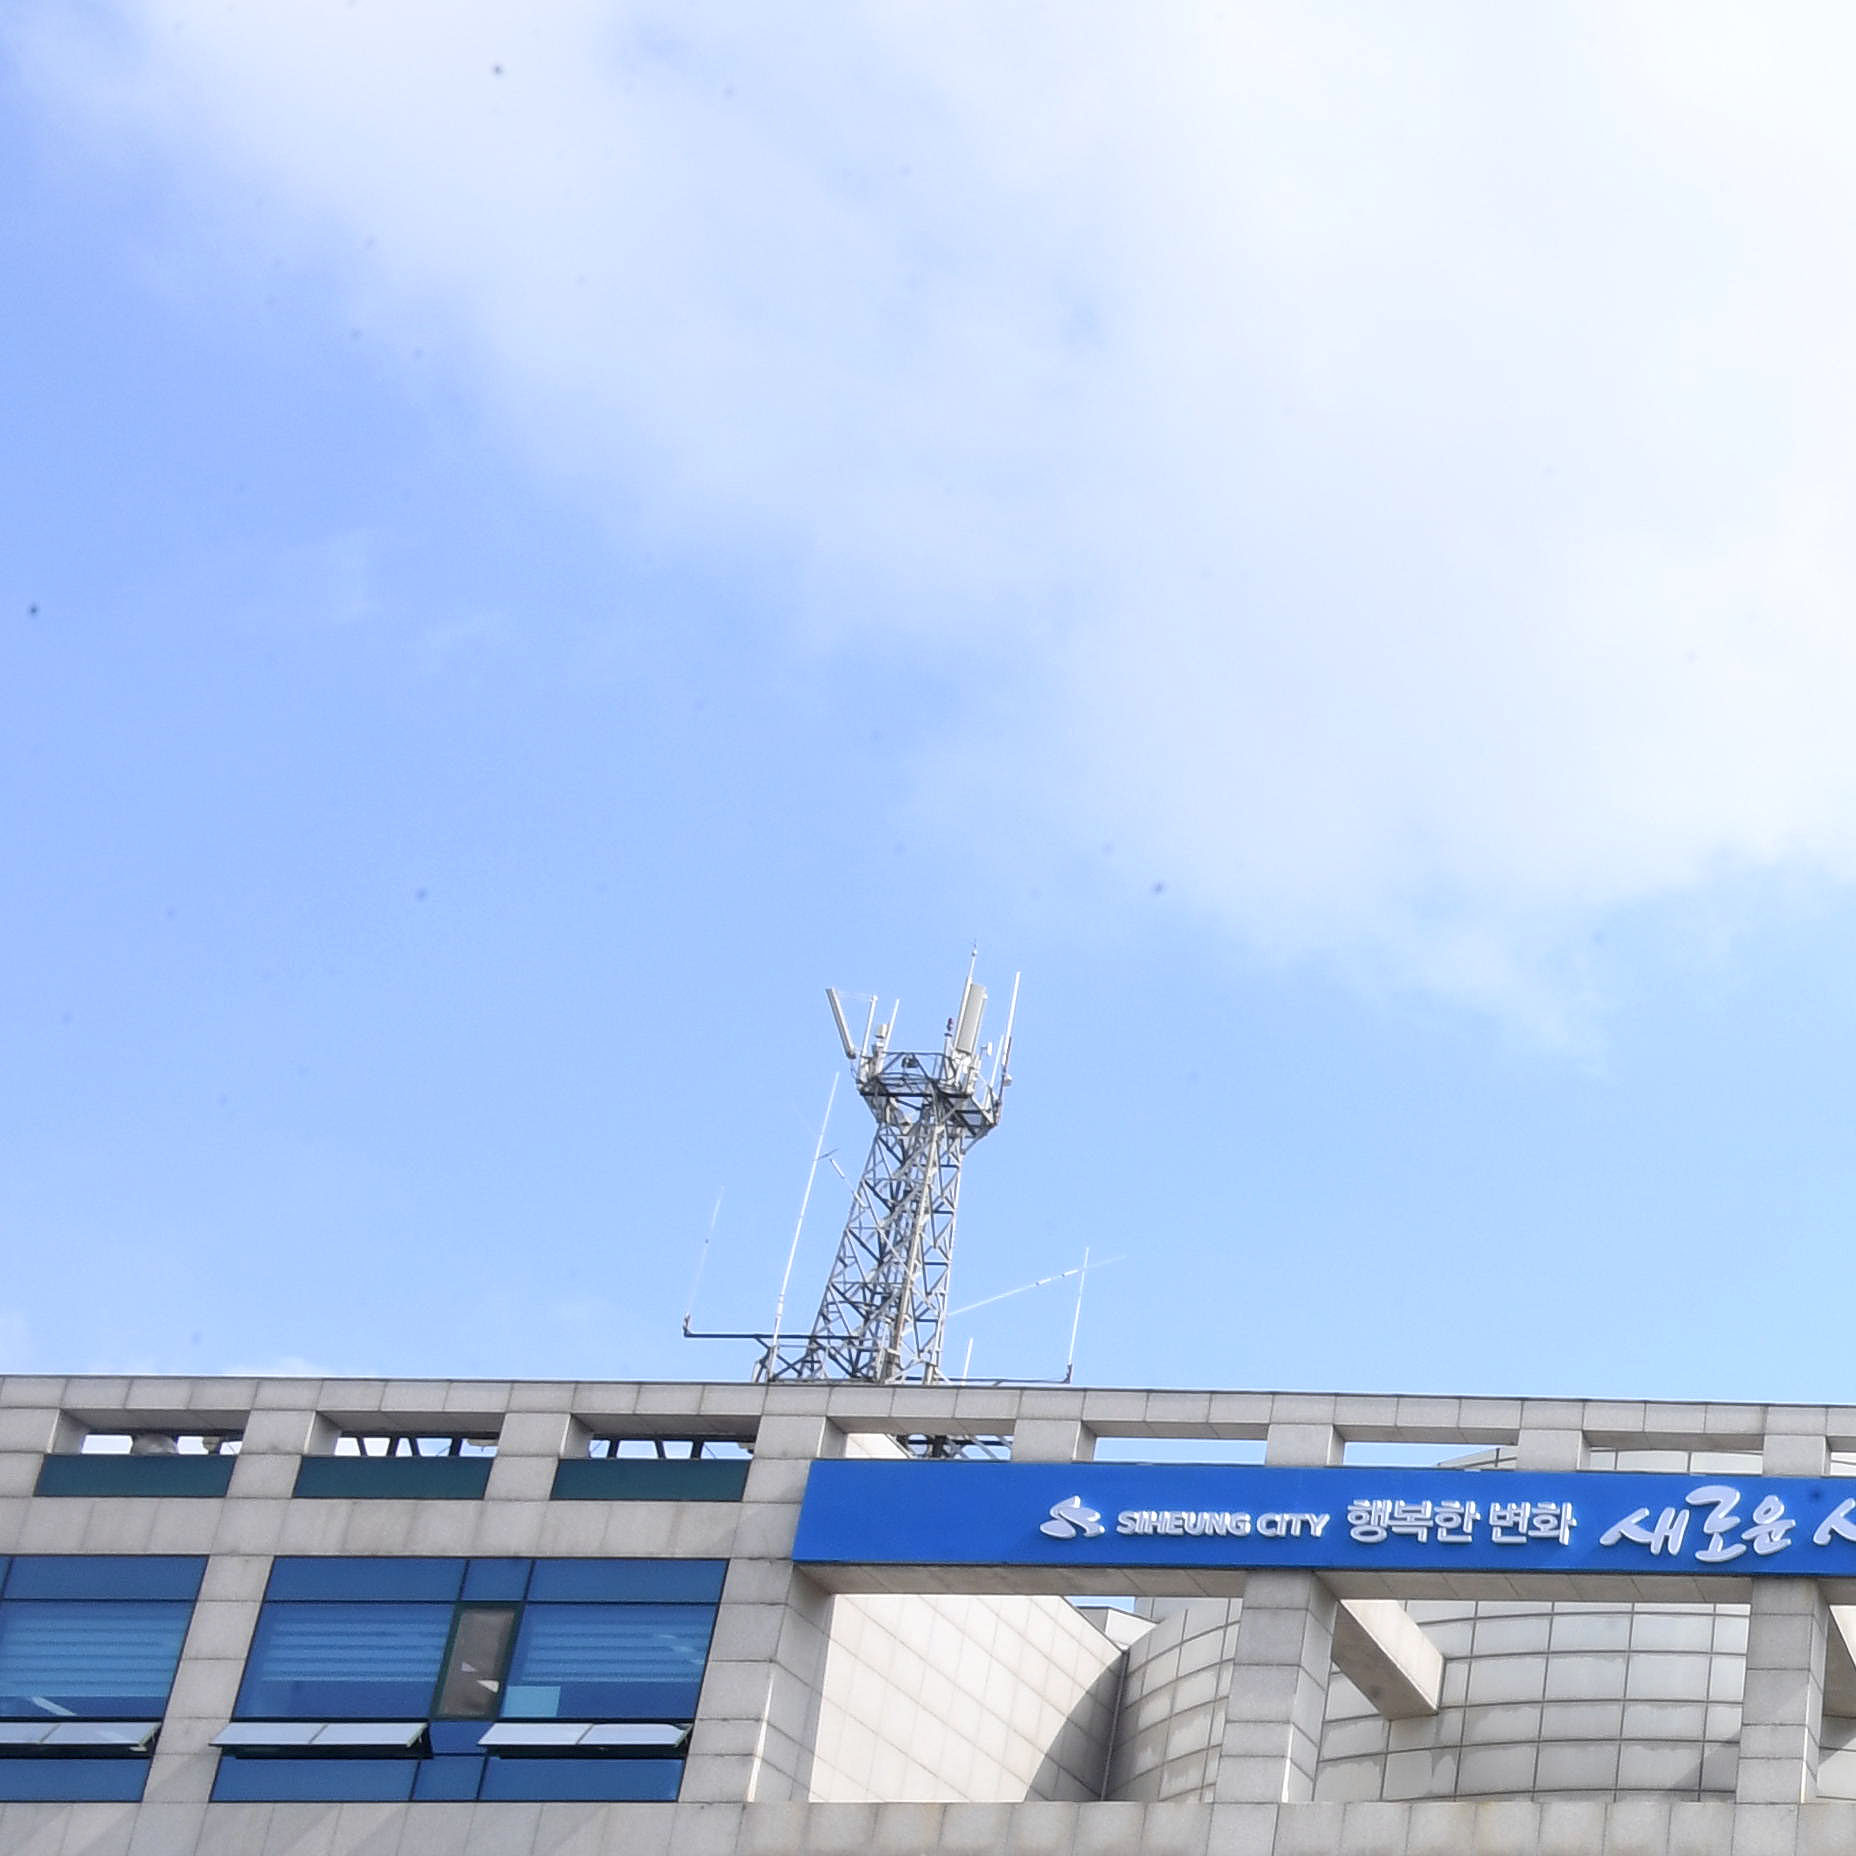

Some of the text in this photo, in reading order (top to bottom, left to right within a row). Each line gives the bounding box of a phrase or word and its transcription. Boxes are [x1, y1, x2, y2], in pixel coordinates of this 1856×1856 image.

[1117, 1510, 1331, 1538] SIHEUNG CITY
[1347, 1499, 1480, 1543] 행복한
[1490, 1501, 1578, 1546] 변화
[1600, 1485, 1796, 1562] 새로운
